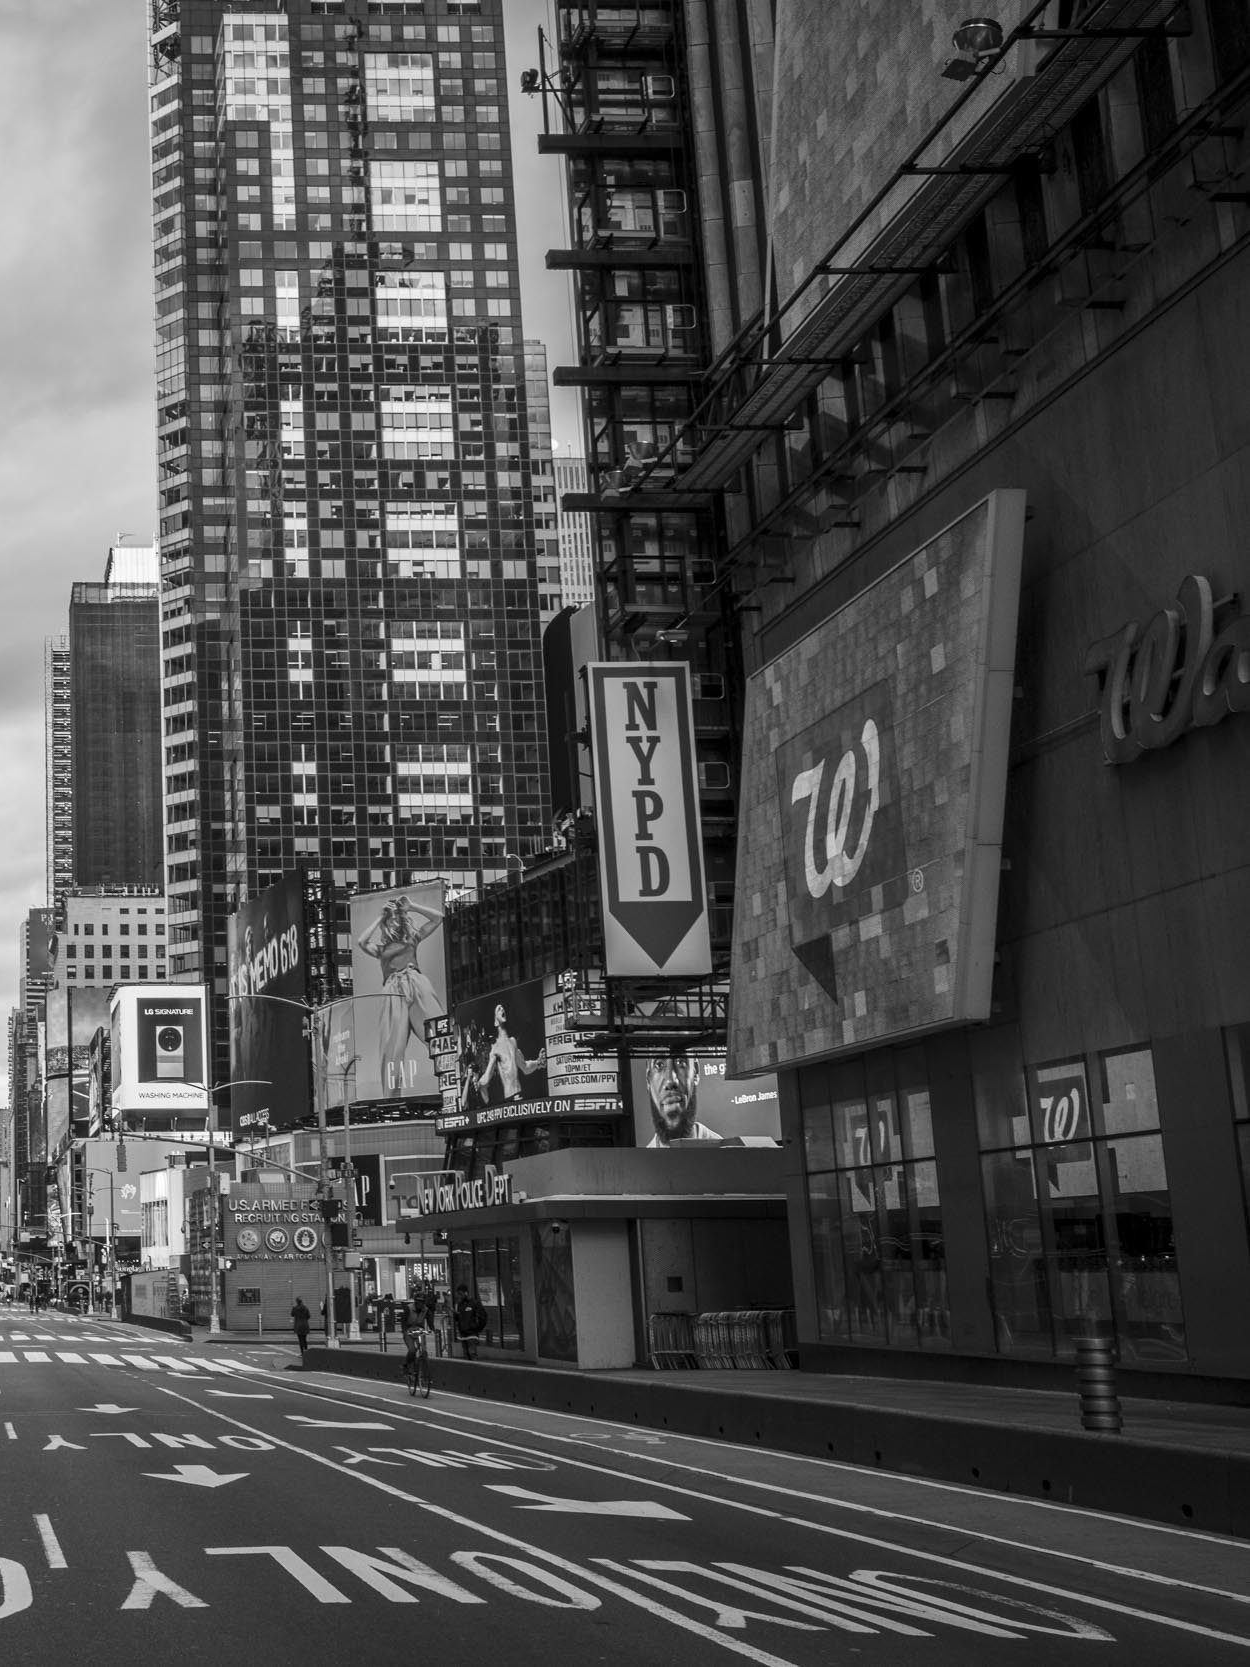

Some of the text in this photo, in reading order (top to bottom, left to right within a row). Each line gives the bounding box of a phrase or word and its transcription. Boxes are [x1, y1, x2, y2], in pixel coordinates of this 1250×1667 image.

[622, 681, 670, 898] NYPD
[250, 937, 279, 996] MEMO
[280, 923, 299, 974] 618
[387, 1060, 417, 1090] GAP
[565, 1064, 592, 1073] 10PM/ET
[704, 1063, 718, 1076] the
[553, 1074, 616, 1087] ESPNPLUS.COM/PPV
[757, 1091, 778, 1101] James
[503, 1101, 552, 1118] EXCLUSIVELY
[554, 1099, 571, 1112] ON
[417, 1177, 434, 1215] NEW
[434, 1175, 455, 1214] YORK
[455, 1169, 484, 1211] POLICE
[485, 1164, 510, 1207] DEPT
[229, 1199, 251, 1211] U.S.
[252, 1199, 298, 1211] ARMED
[235, 1213, 299, 1223] RECRUITNG
[301, 1213, 347, 1223] STAON
[42, 1432, 277, 1452] ONLY
[330, 1445, 558, 1471] ONLY
[120, 1544, 602, 1611] ONLY
[589, 1556, 1117, 1642] ONLY
